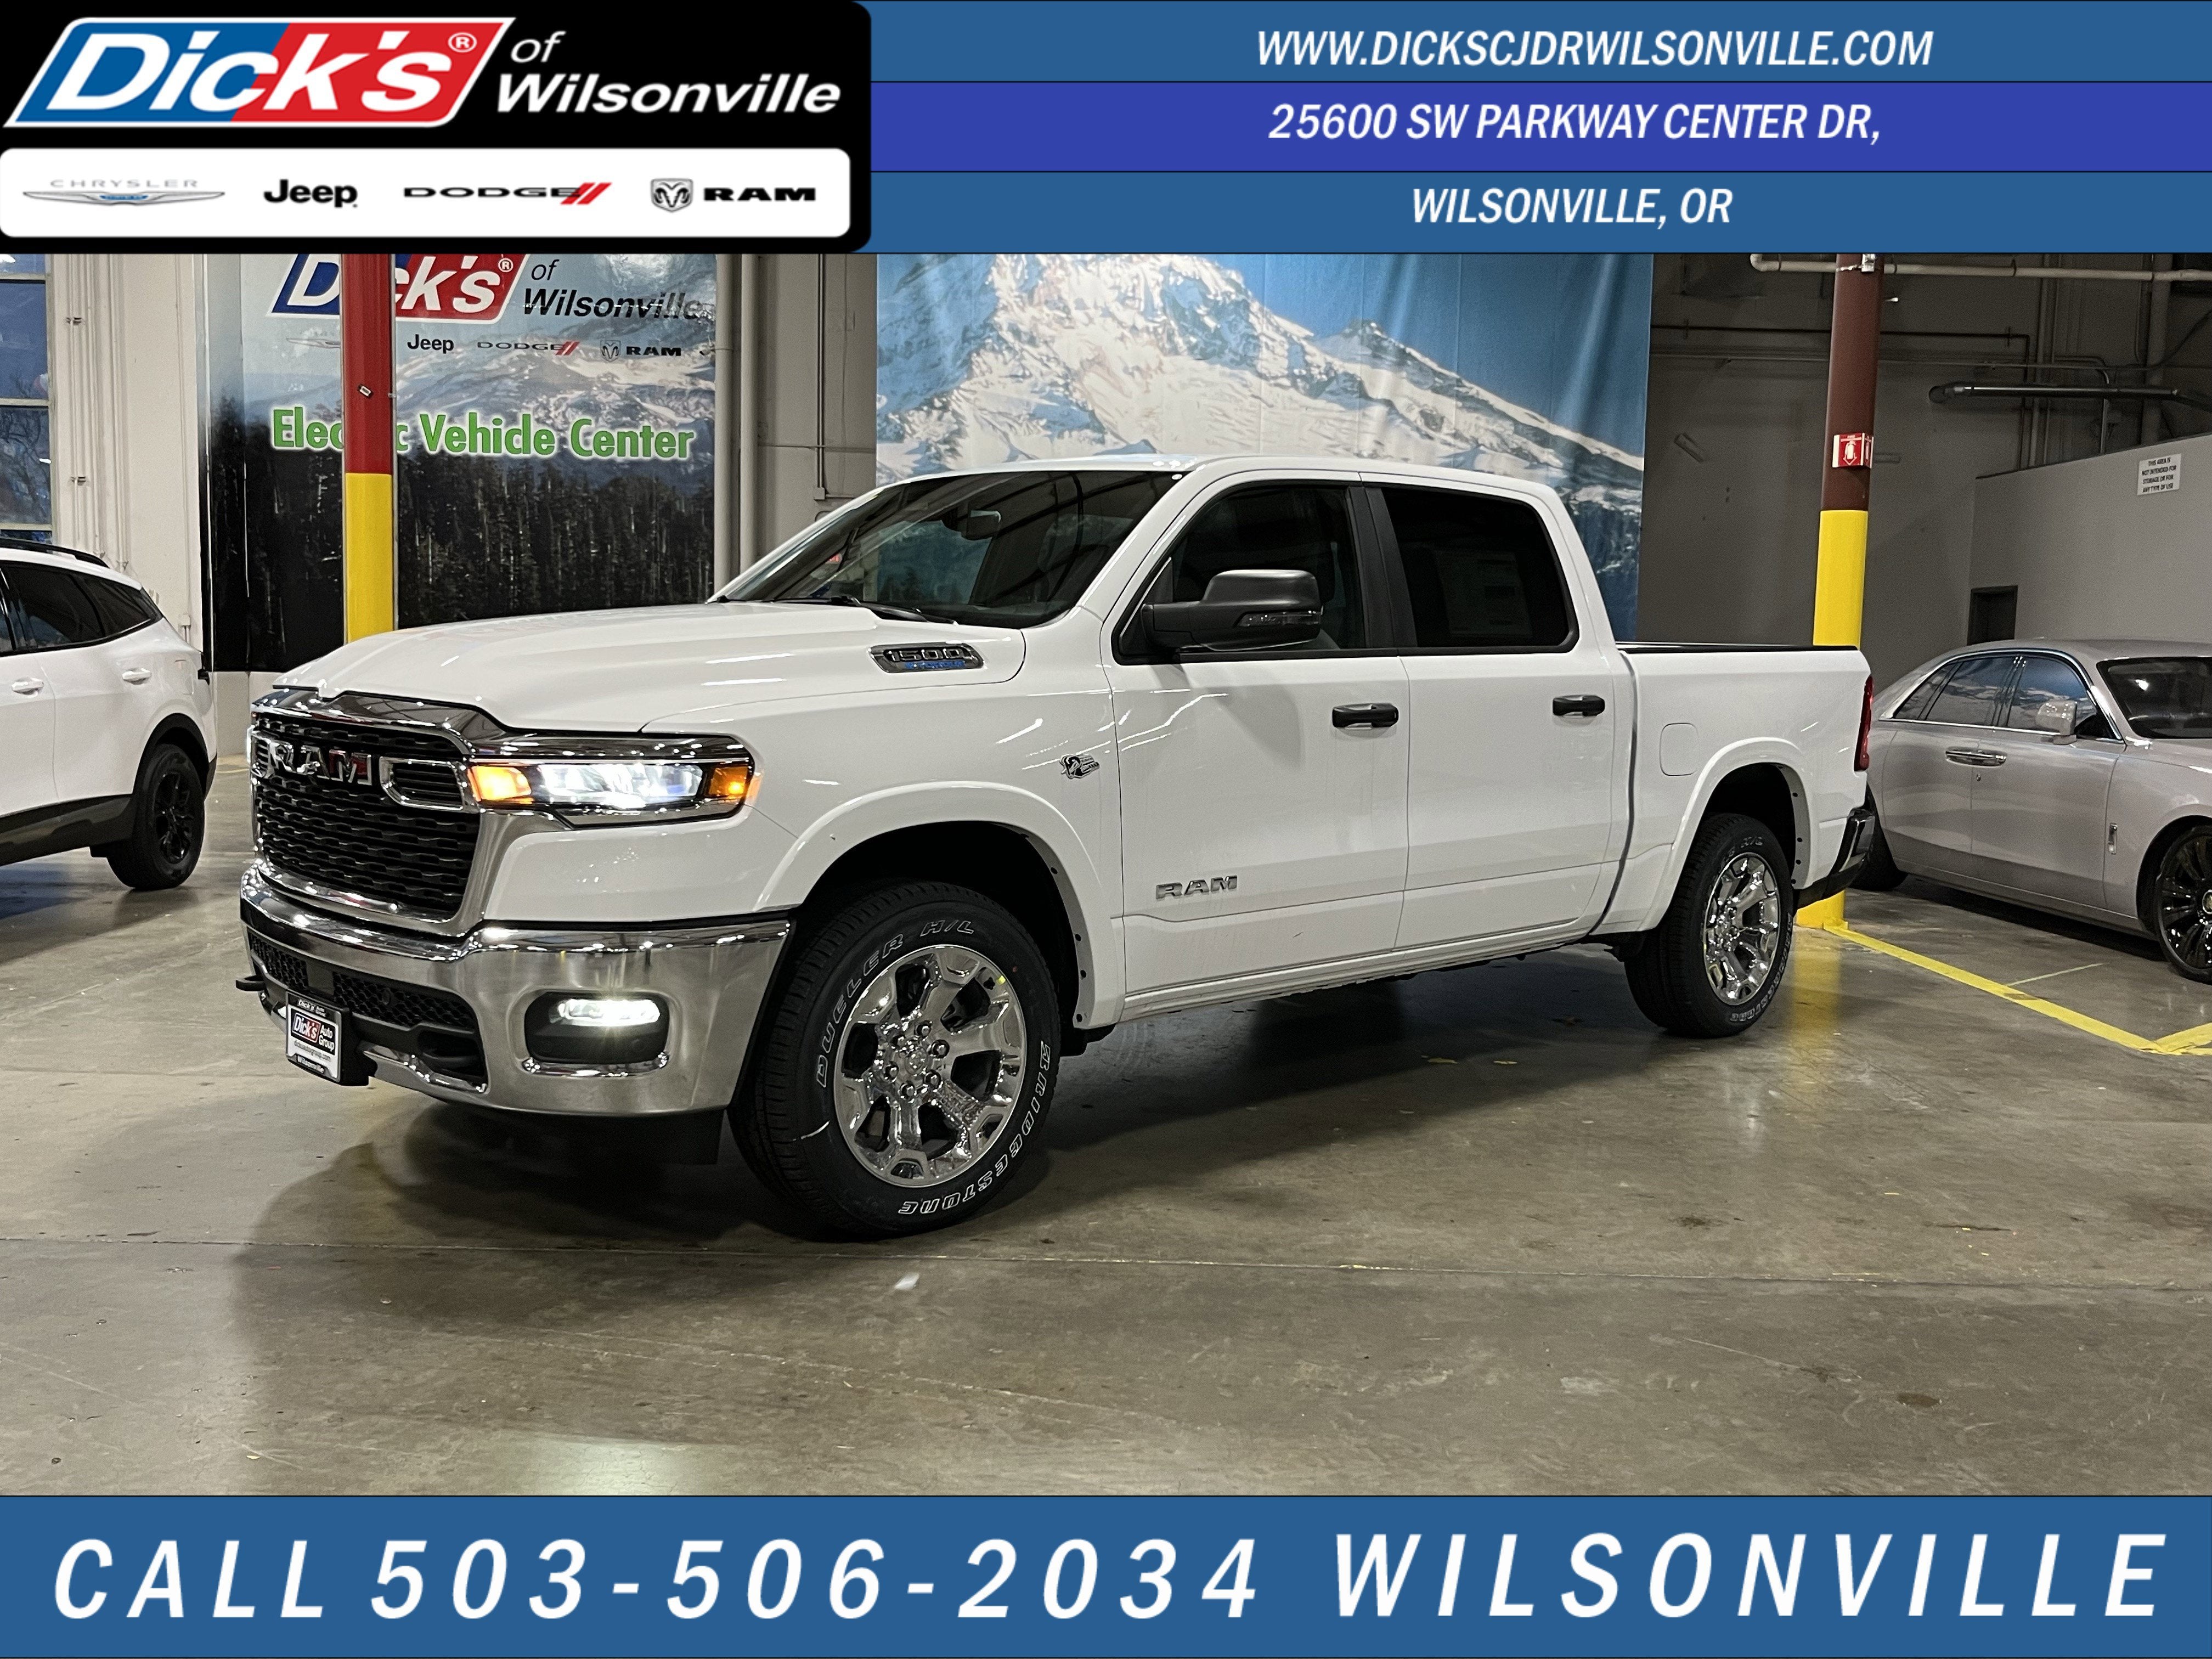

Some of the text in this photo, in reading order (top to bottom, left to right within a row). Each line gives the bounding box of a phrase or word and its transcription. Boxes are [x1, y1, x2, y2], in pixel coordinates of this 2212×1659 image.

[531, 259, 560, 281] of
[524, 288, 704, 319] Wilsonville
[407, 334, 455, 354] Jeep
[477, 342, 565, 351] DODGE
[625, 346, 682, 357] RAM
[273, 407, 695, 458] Elecc Vehicle Center
[889, 648, 964, 662] 1500
[268, 740, 373, 786] RAM
[1156, 875, 1237, 900] RAM
[817, 919, 975, 1088] DUELER H/L
[294, 1016, 333, 1040] Dick's Auto
[319, 1035, 335, 1052] Group
[898, 1040, 1051, 1215] BRIDGESTONE
